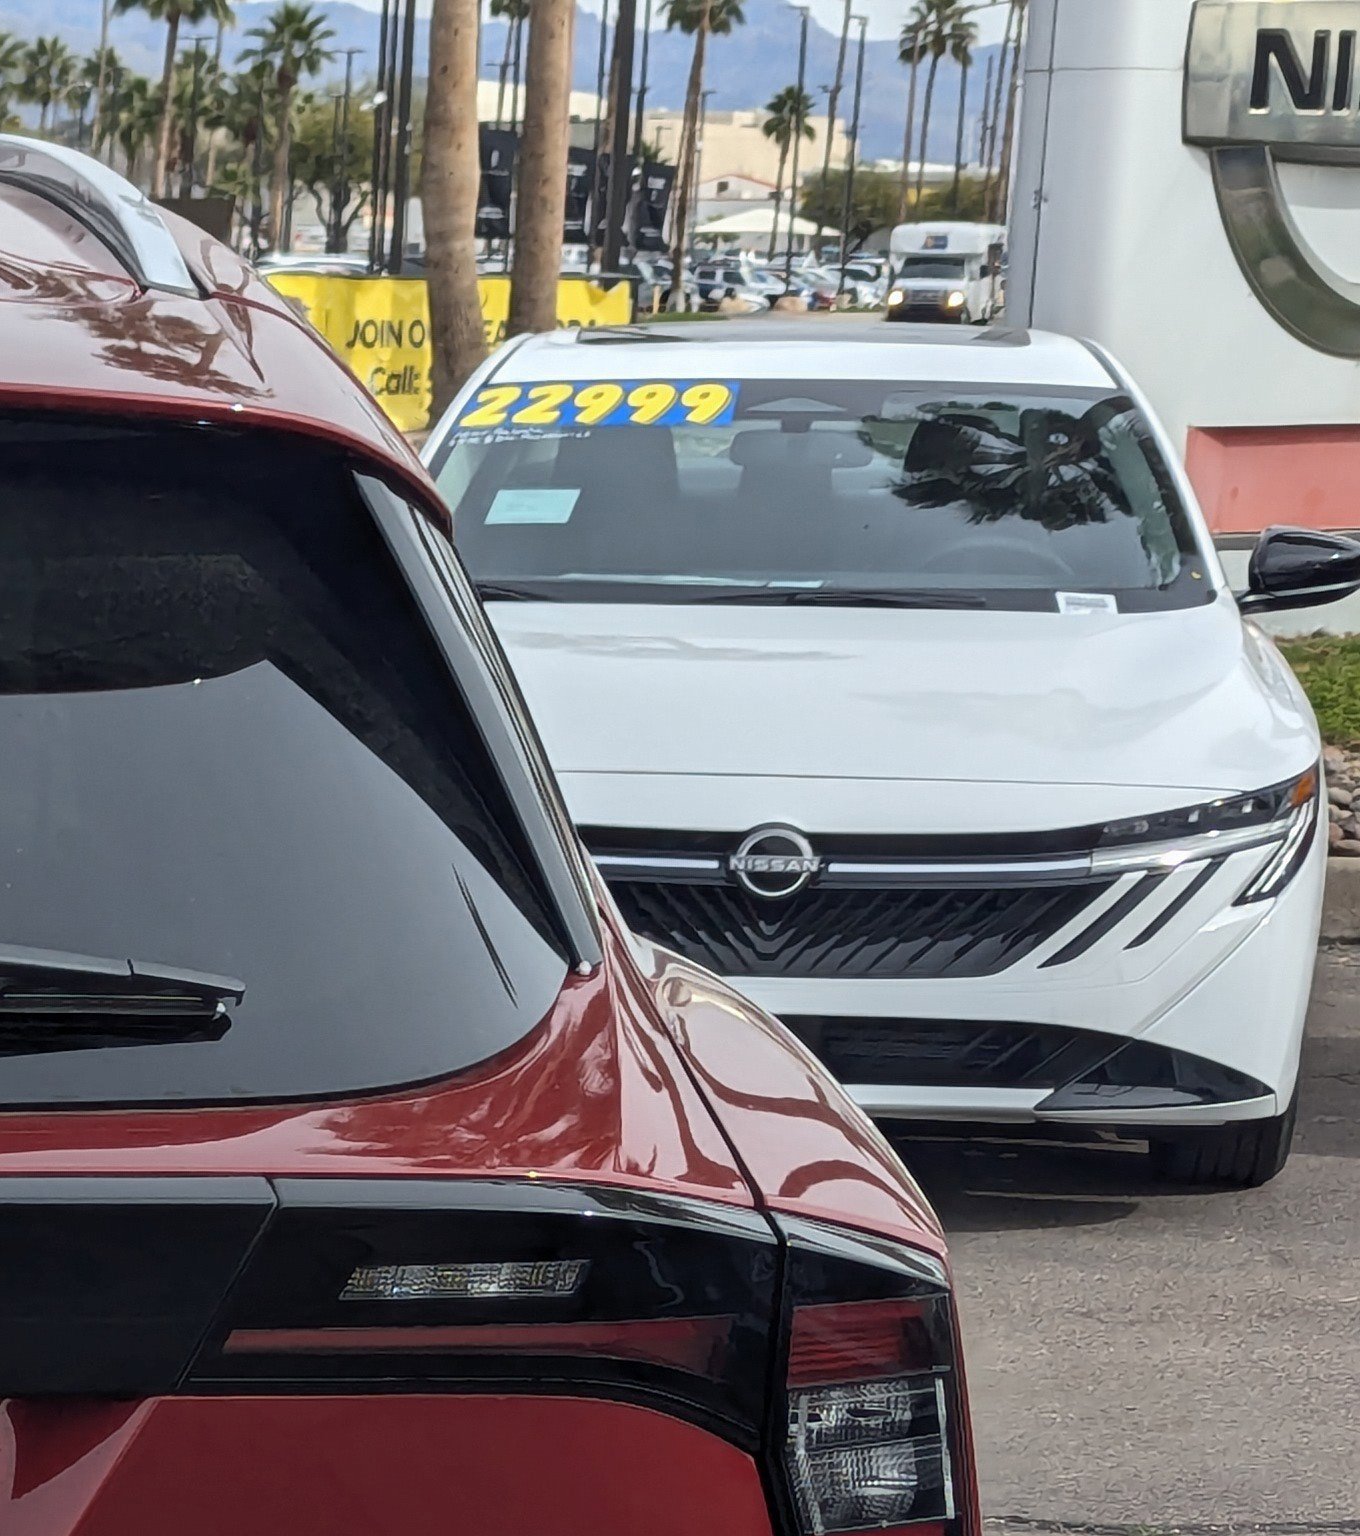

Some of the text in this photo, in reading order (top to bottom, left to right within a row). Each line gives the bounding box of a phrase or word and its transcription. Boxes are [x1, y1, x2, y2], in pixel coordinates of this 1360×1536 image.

[346, 319, 403, 350] JOIN
[370, 366, 418, 396] Call:
[459, 383, 733, 427] 22999
[730, 857, 821, 872] NISSAN
